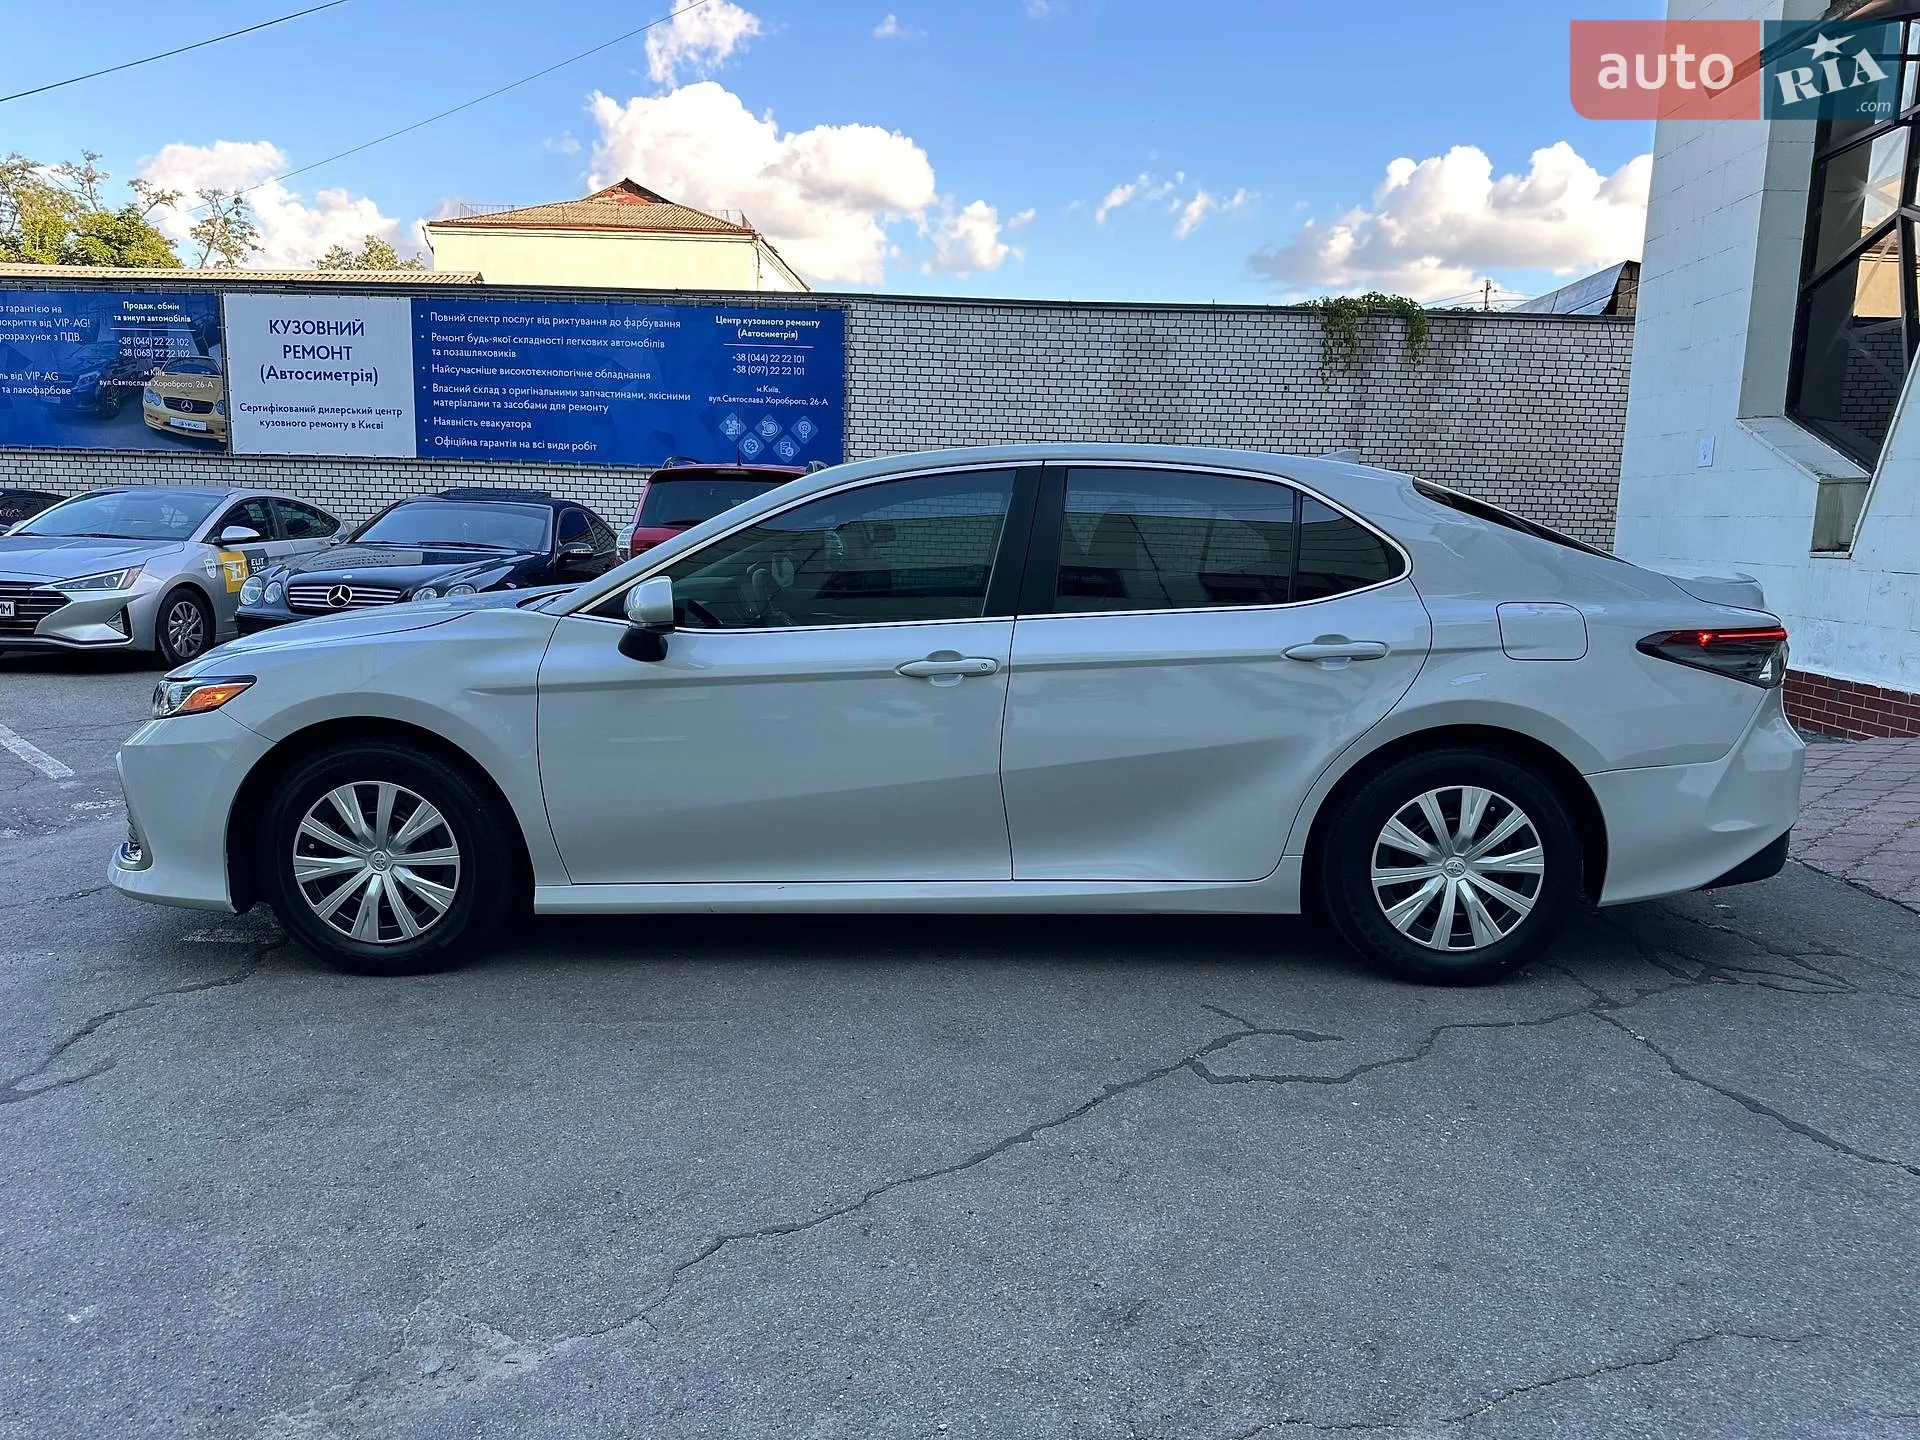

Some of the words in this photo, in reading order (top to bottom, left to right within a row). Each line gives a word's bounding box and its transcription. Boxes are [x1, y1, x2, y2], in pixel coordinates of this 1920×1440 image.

[6, 305, 50, 315] гарантією
[123, 301, 156, 311] Продаж,
[158, 302, 180, 310] обмін
[40, 319, 52, 328] від
[54, 318, 91, 328] VIP-AG!
[123, 315, 146, 323] викуп
[147, 314, 191, 323] автомобілів
[430, 312, 466, 322] Повний
[467, 315, 500, 325] спектр
[502, 317, 534, 326] послуг
[537, 315, 550, 325] від
[552, 317, 607, 327] рихтування
[609, 319, 621, 327] до
[623, 317, 681, 330] фарбування
[715, 316, 741, 327] Центр
[743, 318, 784, 327] кузовного
[785, 319, 820, 328] ремонту
[269, 318, 365, 337] КУЗОВНИЙ
[60, 332, 82, 343] ПДВ.
[431, 332, 465, 342] Ремонт
[467, 333, 511, 345] будь-якої
[513, 336, 564, 345] складності
[566, 338, 608, 347] легкових
[610, 338, 665, 348] автомобілів
[738, 329, 798, 340] (Автосиметрія)
[133, 337, 153, 348] (044)
[154, 337, 164, 346] 22
[165, 338, 175, 346] 22
[176, 338, 190, 346] 102
[134, 349, 154, 359] (068)
[155, 349, 165, 358] 22
[166, 349, 176, 358] 22
[177, 349, 190, 358] 102
[283, 344, 353, 361] РЕМОНТ
[432, 348, 441, 356] та
[443, 348, 517, 358] позашляховиків
[732, 353, 746, 362] +38
[748, 353, 769, 364] (044)
[770, 355, 780, 363] 22
[782, 355, 792, 363] 22
[793, 355, 805, 363] 101
[10, 372, 23, 381] від
[25, 371, 59, 381] VIP-AG
[260, 363, 379, 387] (Автосиметрія)
[432, 364, 498, 376] Найсучасніше
[499, 368, 593, 378] високотехнологічне
[595, 368, 651, 380] обладнання
[733, 365, 746, 374] +38
[748, 365, 769, 376] (097)
[770, 366, 780, 375] 22
[782, 366, 792, 375] 22
[793, 367, 805, 375] 101
[13, 385, 72, 397] лакофарбове
[432, 383, 471, 393] Власний
[473, 386, 500, 395] склад
[502, 387, 507, 395] з
[508, 387, 578, 397] оригінальними
[580, 389, 647, 400] запчастинами,
[648, 391, 691, 401] якісними
[433, 399, 490, 409] матеріалами
[503, 400, 547, 410] засобами
[549, 403, 566, 411] для
[568, 404, 609, 415] ремонту
[810, 398, 829, 406] 26-А
[239, 402, 316, 415] Сертифікований
[318, 405, 373, 417] дилерський
[375, 408, 403, 418] центр
[259, 419, 307, 428] кузовного
[309, 421, 349, 431] ремонту
[358, 420, 384, 430] Києві
[433, 417, 479, 427] Наявність
[480, 420, 532, 430] евакуатора
[434, 436, 478, 448] Офіційна
[480, 440, 517, 450] гарантія
[532, 440, 545, 449] всі
[572, 441, 597, 452] робіт
